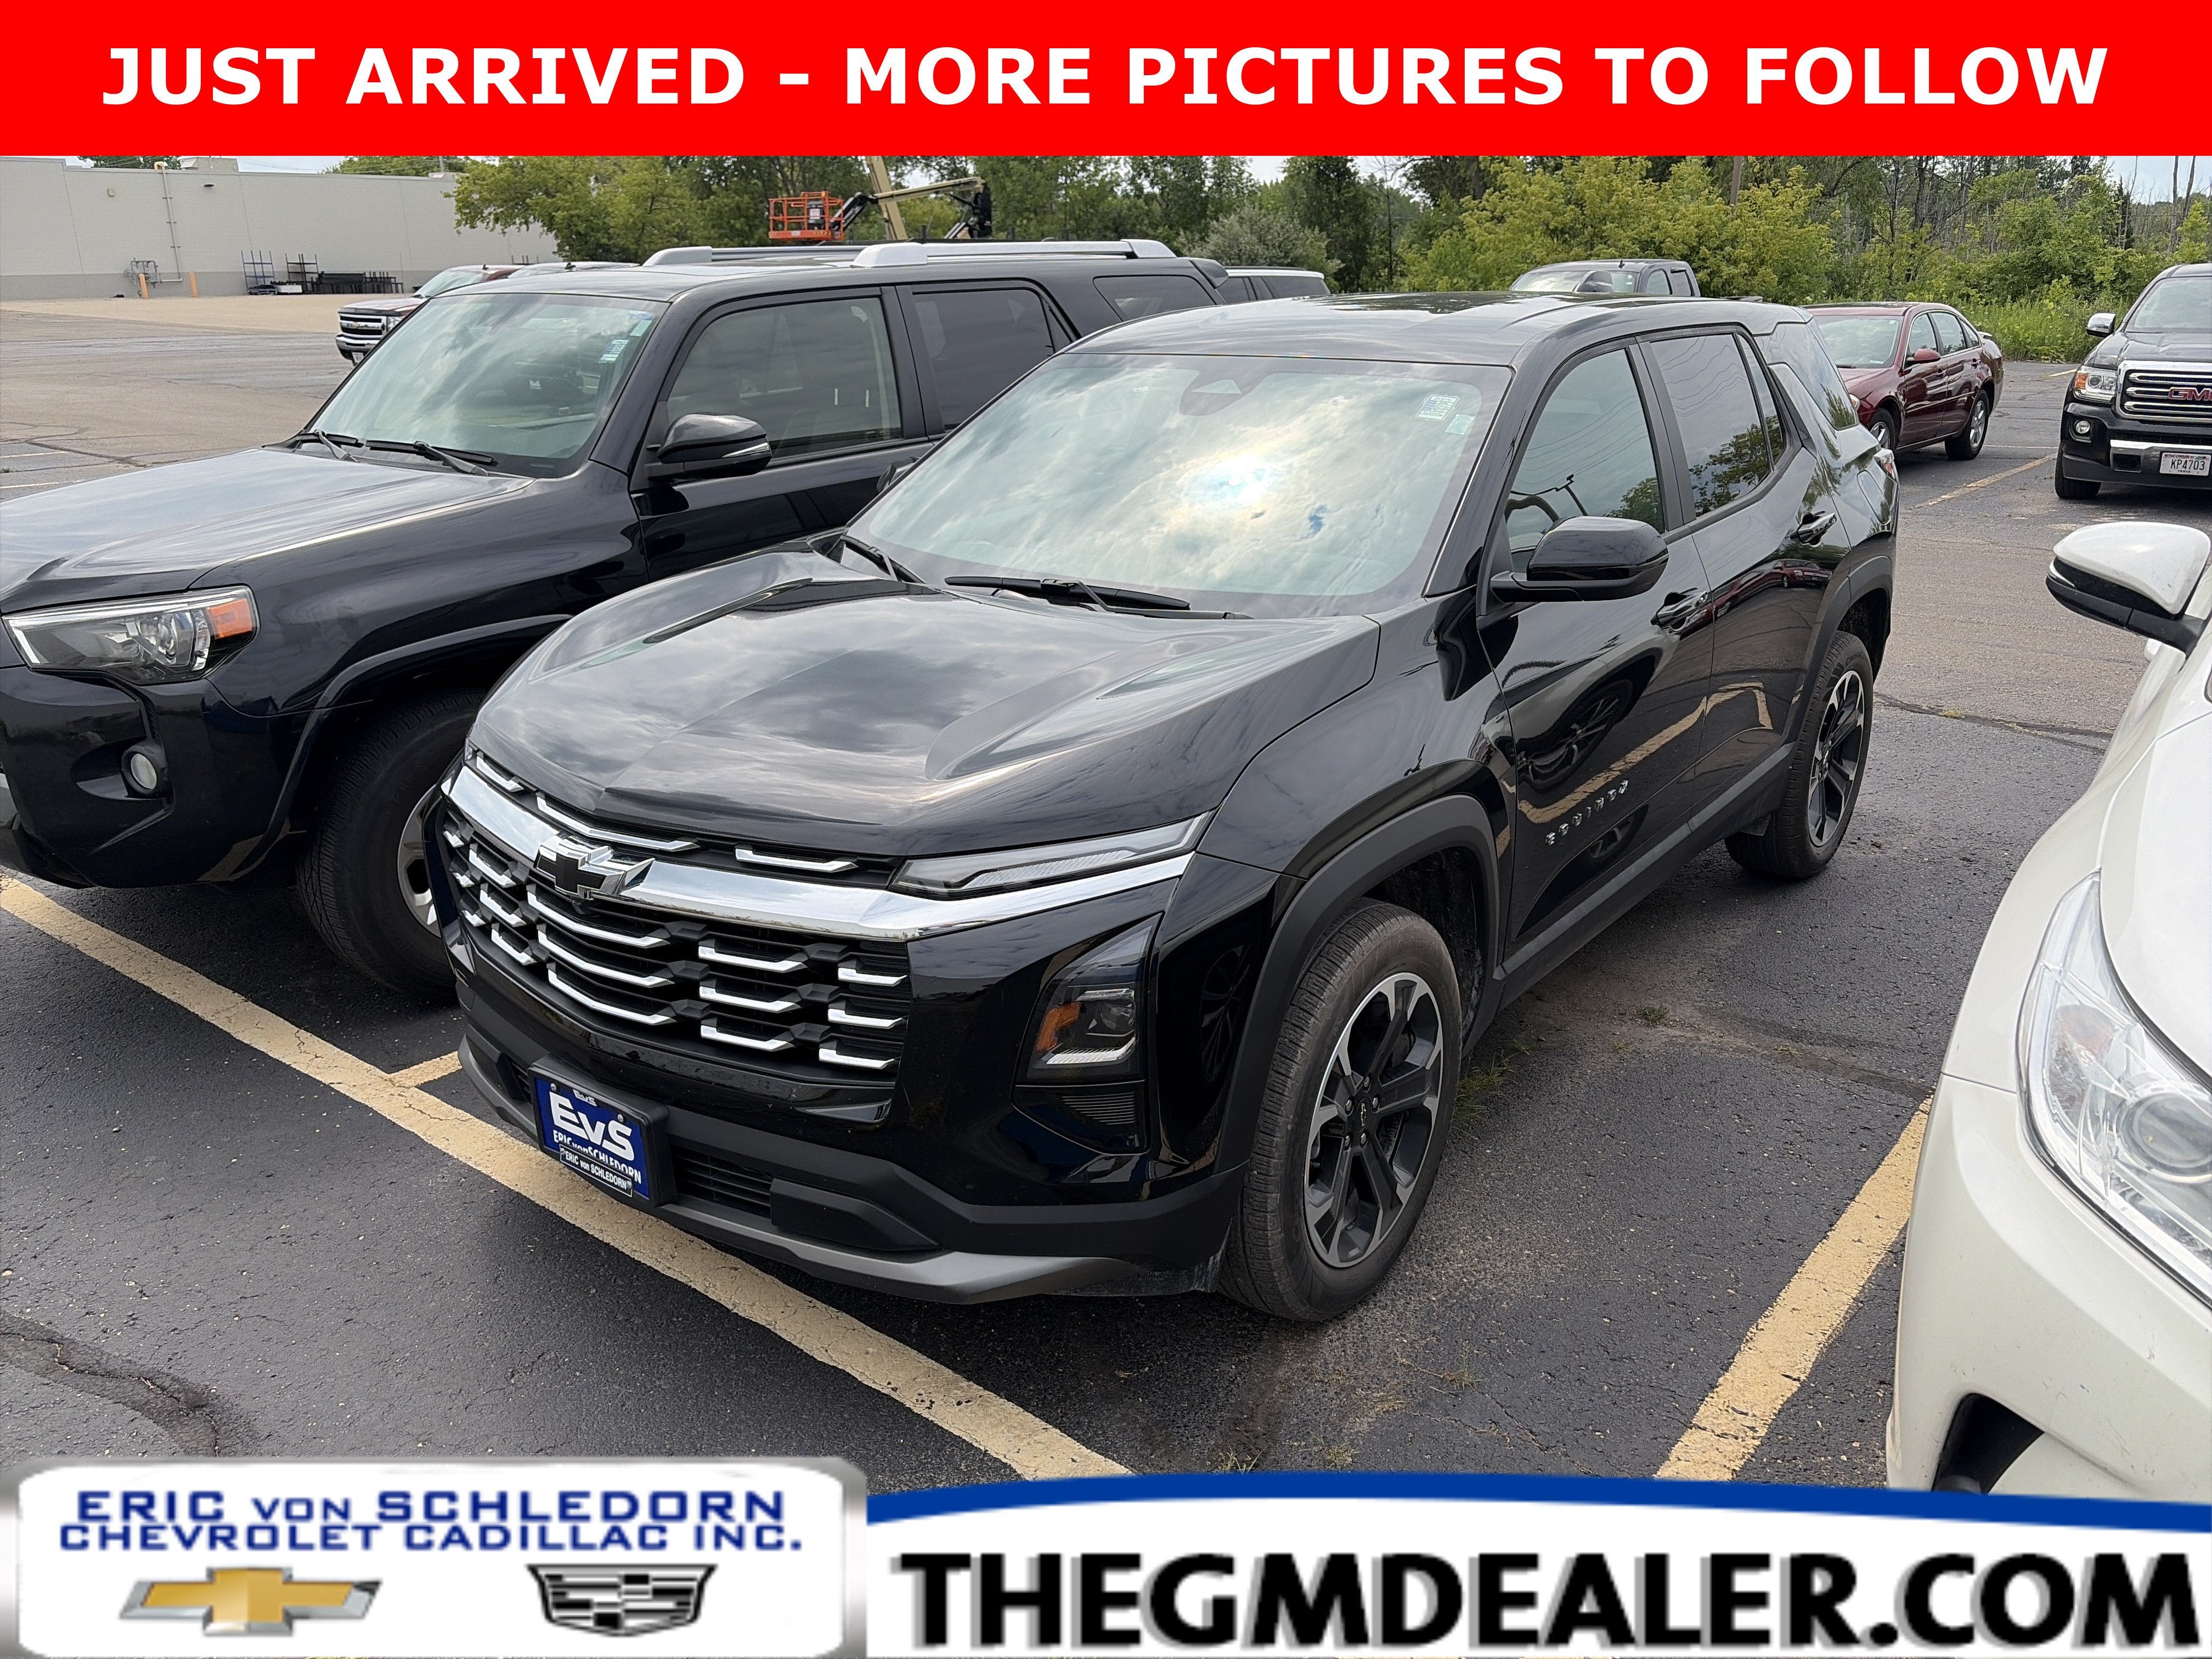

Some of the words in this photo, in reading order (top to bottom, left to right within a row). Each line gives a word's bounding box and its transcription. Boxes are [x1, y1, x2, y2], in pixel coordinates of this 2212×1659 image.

[2169, 387, 2212, 401] GM
[2170, 459, 2205, 470] KP4703
[552, 1129, 572, 1146] ERIC
[588, 1146, 642, 1184] SCHLEDORN
[566, 1151, 579, 1165] ERIC
[579, 1160, 590, 1172] von
[590, 1163, 627, 1190] SCHLEDORN
